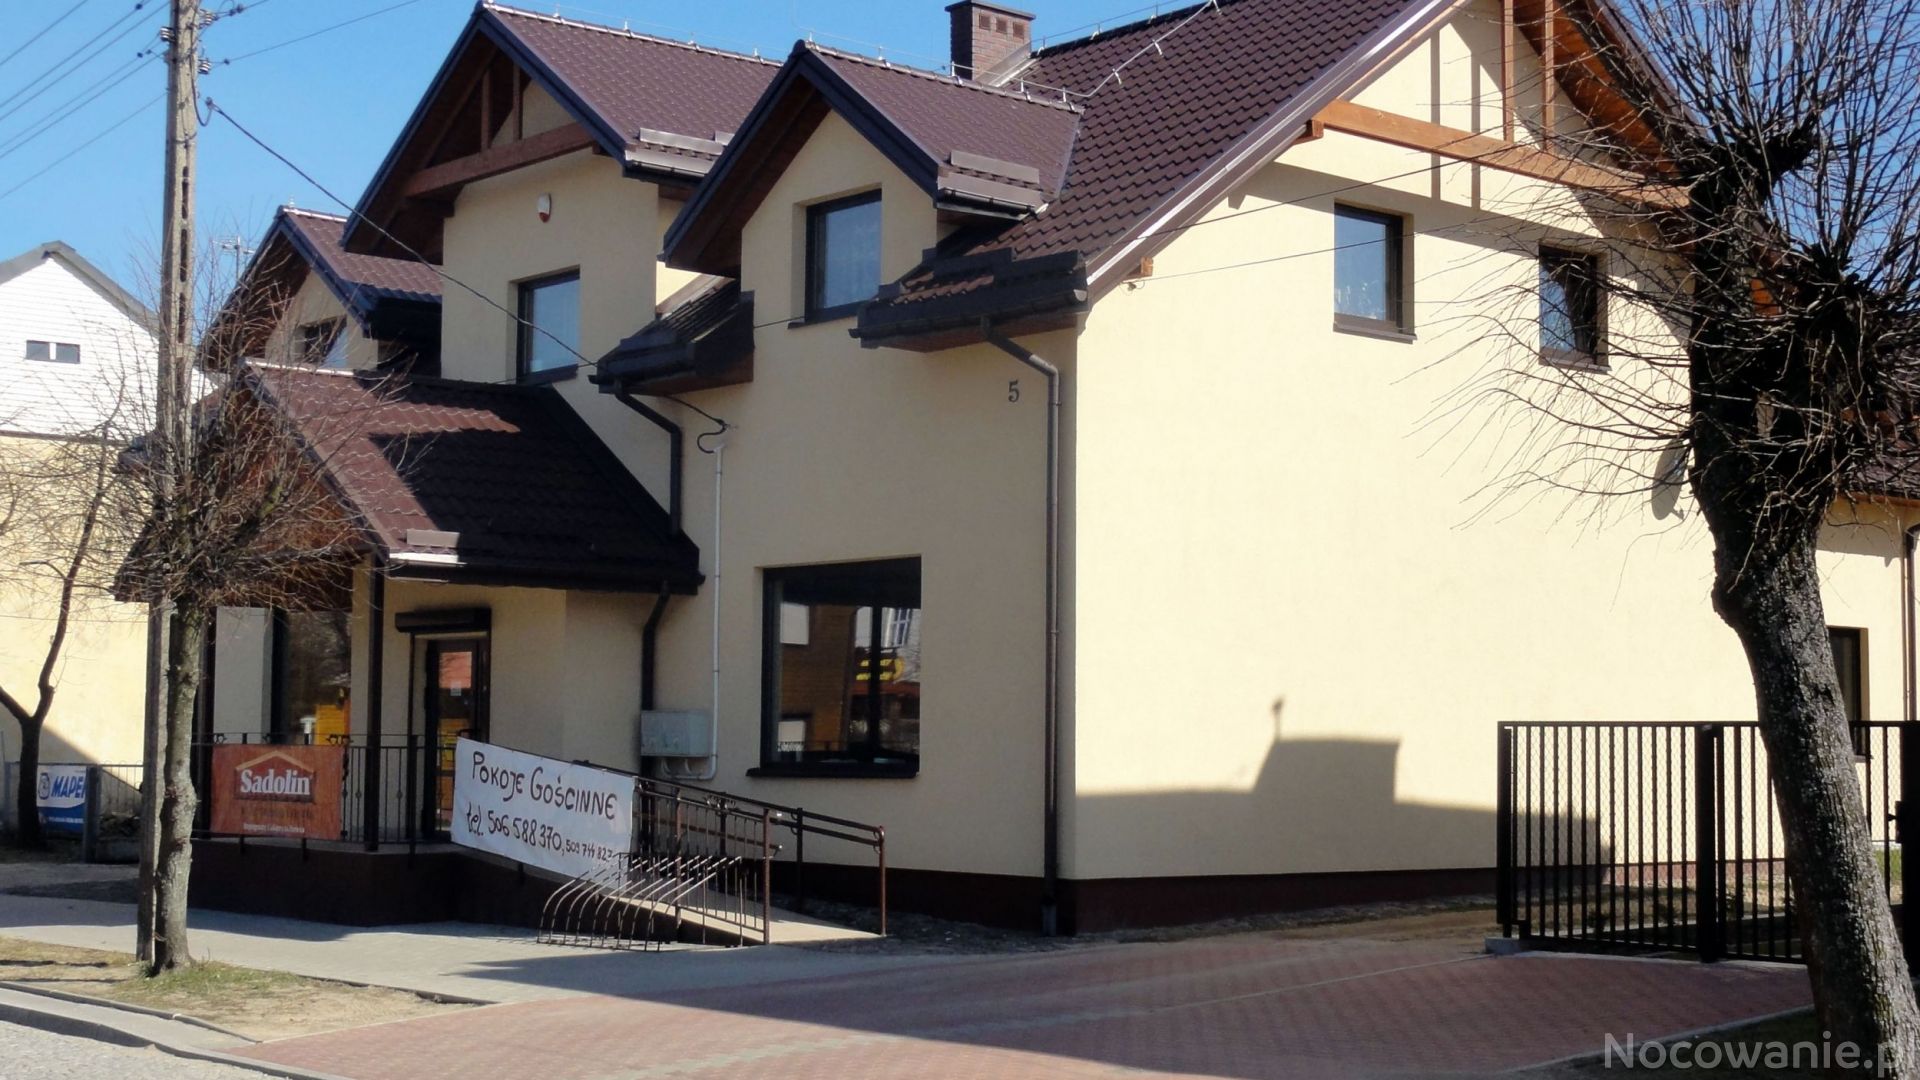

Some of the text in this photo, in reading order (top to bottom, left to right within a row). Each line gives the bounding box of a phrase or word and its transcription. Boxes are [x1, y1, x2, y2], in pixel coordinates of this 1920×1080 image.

[1008, 379, 1020, 402] 5
[240, 768, 311, 795] Sadolin
[488, 810, 510, 837] 506
[512, 817, 537, 846] 588
